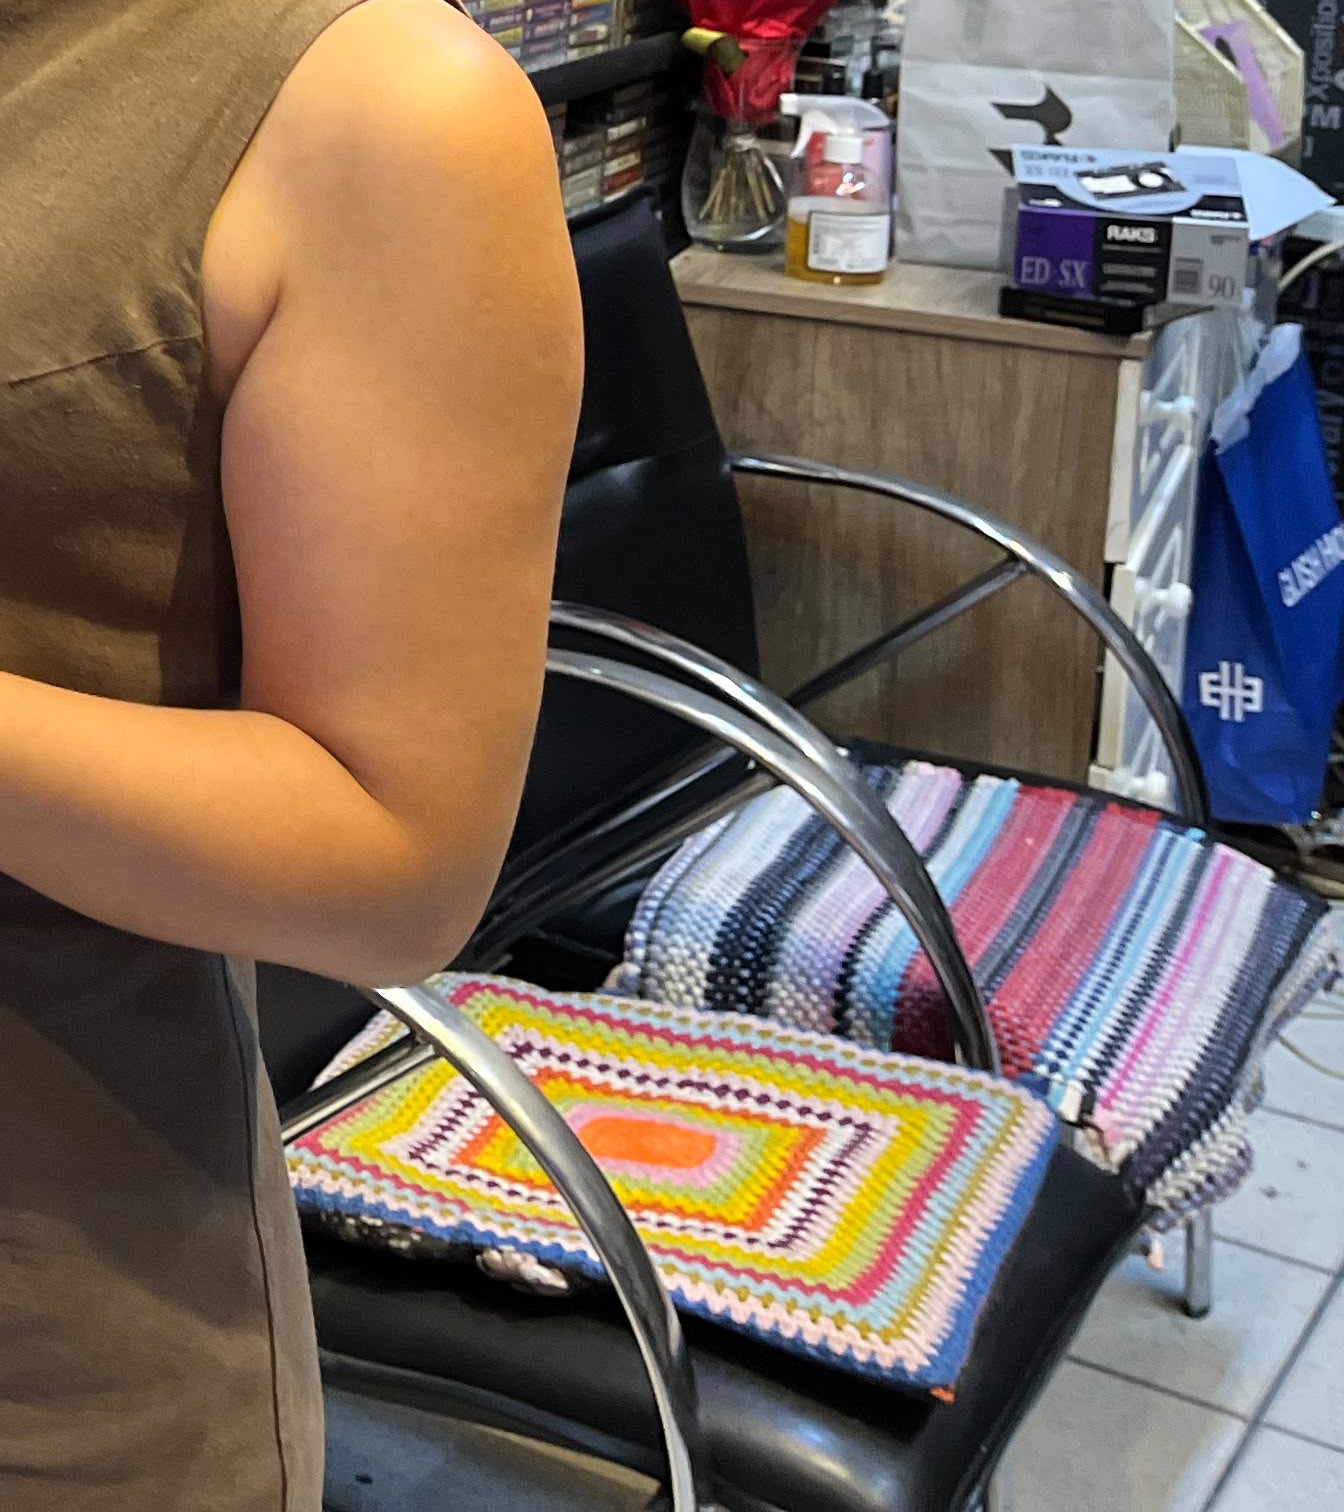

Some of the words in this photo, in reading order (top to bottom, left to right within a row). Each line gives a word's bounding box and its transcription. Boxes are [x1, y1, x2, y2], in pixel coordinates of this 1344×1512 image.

[1107, 225, 1156, 243] RAKS
[1021, 256, 1050, 284] ED
[1059, 258, 1088, 287] SX
